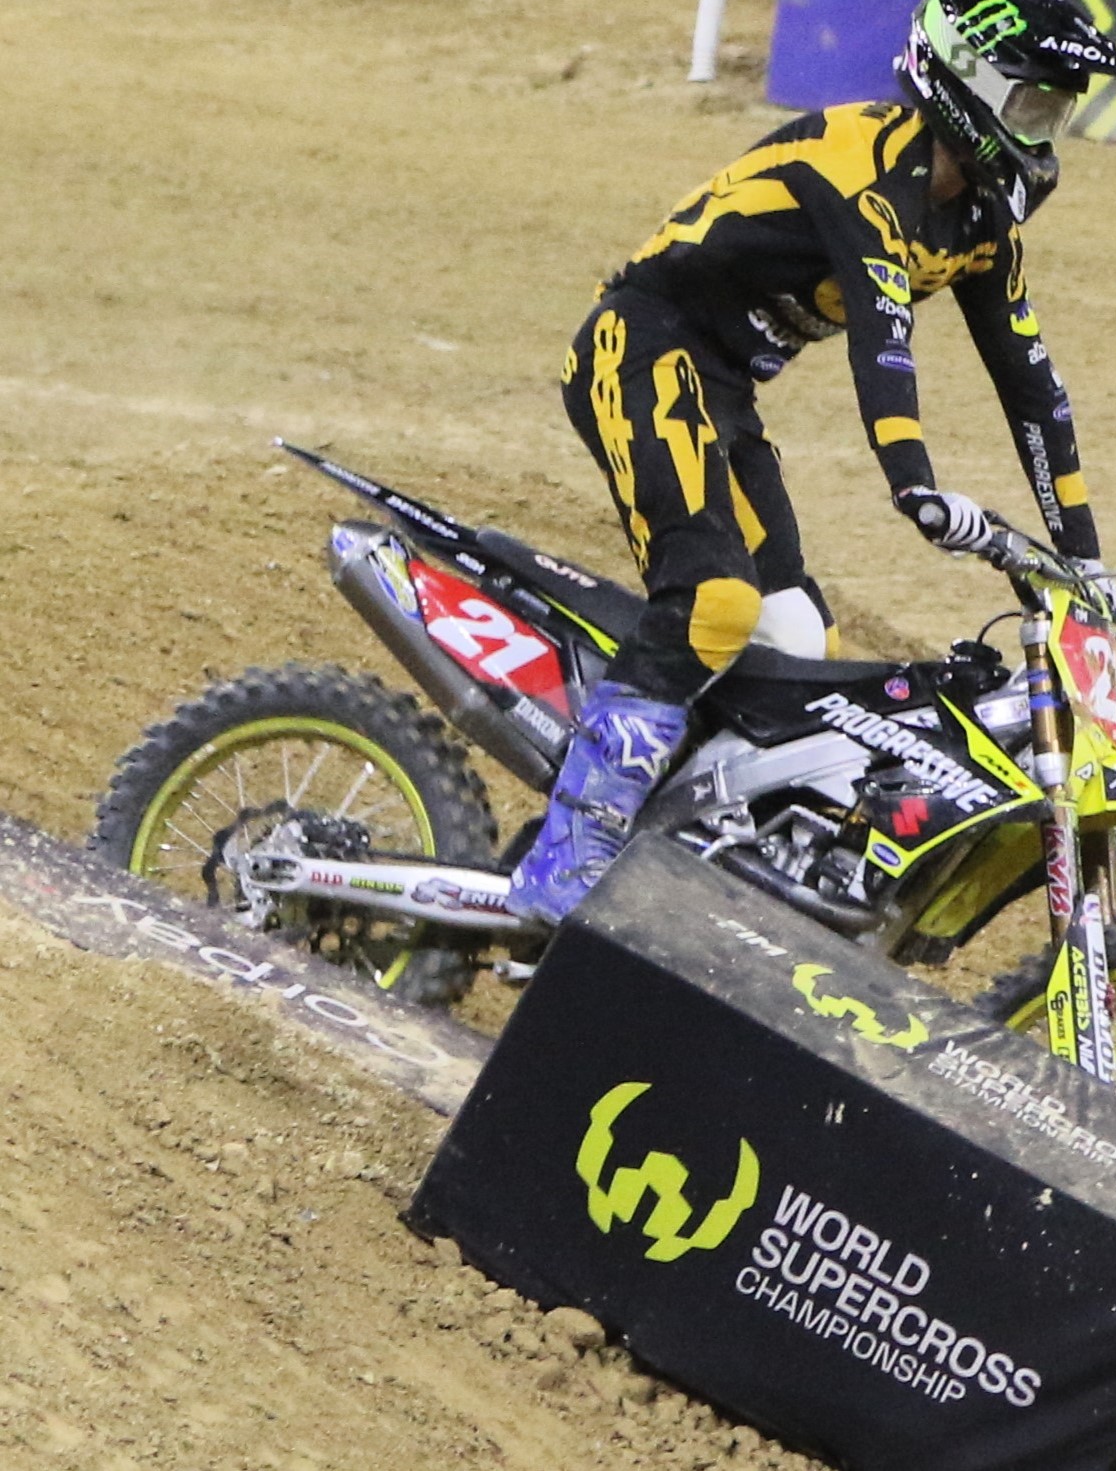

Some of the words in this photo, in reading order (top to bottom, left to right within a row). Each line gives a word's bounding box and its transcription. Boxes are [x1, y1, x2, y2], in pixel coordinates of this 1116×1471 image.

[427, 598, 549, 679] 21
[514, 696, 567, 744] DIXON
[805, 692, 998, 813] PROGRESSIVE
[944, 1041, 1066, 1115] WORLD
[771, 1184, 931, 1297] WORLD
[735, 1265, 967, 1404] CHAMPIONSHIP
[752, 1226, 1042, 1408] SUPERCROSS
